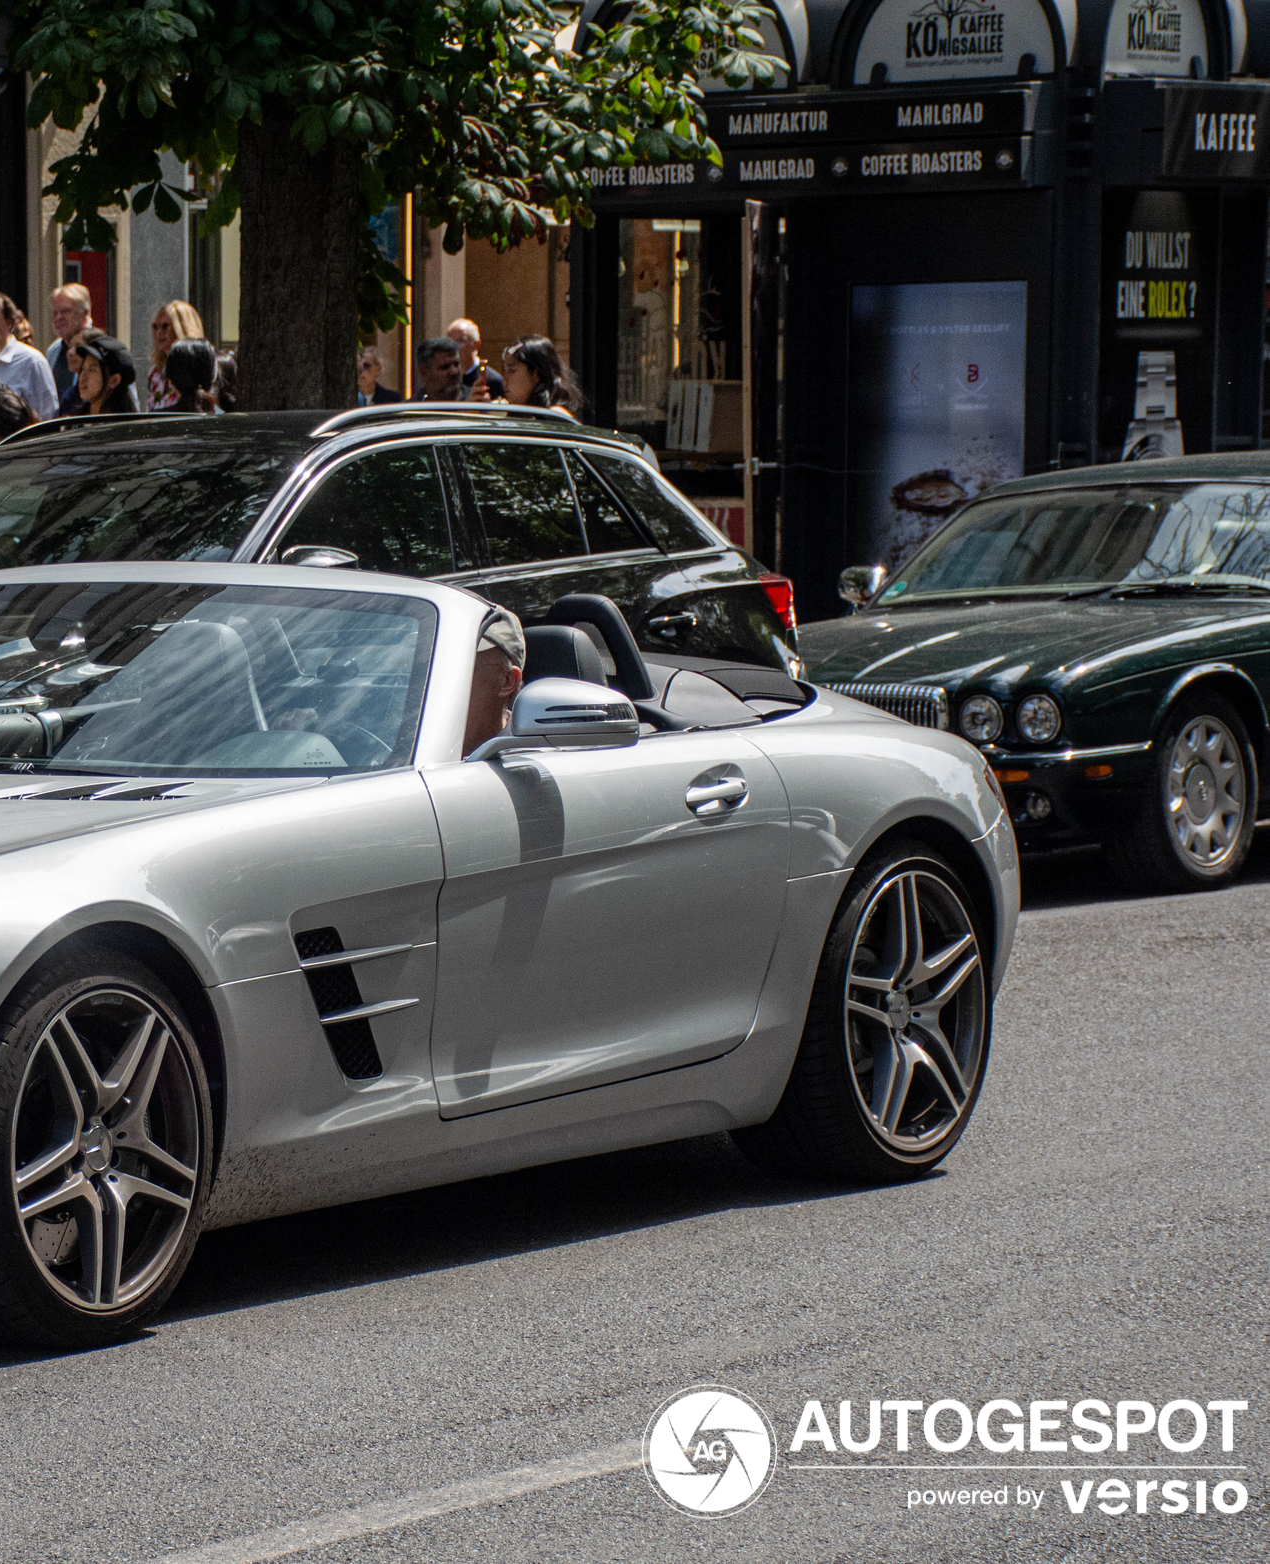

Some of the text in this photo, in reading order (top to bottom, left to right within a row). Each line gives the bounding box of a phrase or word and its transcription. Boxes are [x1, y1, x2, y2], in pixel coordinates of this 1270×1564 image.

[959, 13, 1004, 34] KAFFEE
[1157, 13, 1181, 32] KAFFEE
[728, 110, 828, 136] MANUFAKTUR
[896, 102, 984, 128] MAHLGRAD
[1194, 113, 1257, 152] KAFFEE
[629, 163, 695, 186] ROASTERS
[739, 158, 815, 182] MAHLGRAD
[861, 150, 983, 176] COFFEE ROASTERS
[1125, 231, 1191, 269] DU WILLST
[1116, 280, 1198, 319] EINE ROLEX ?
